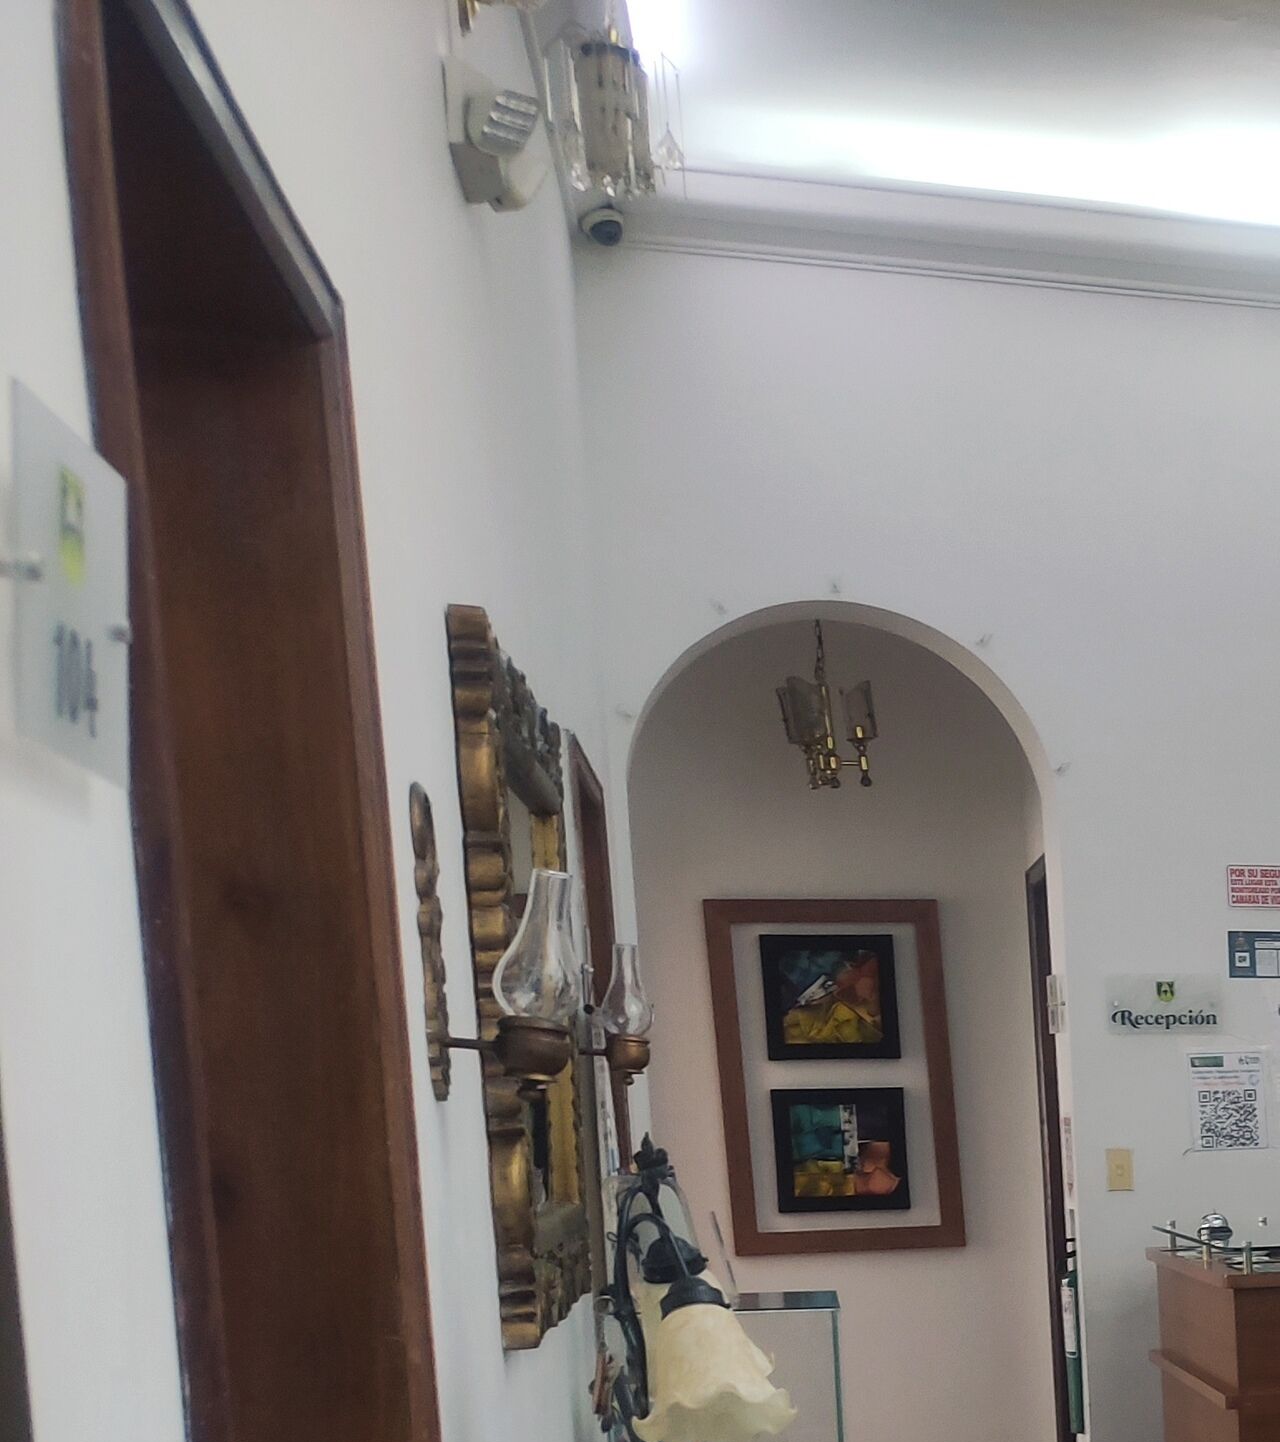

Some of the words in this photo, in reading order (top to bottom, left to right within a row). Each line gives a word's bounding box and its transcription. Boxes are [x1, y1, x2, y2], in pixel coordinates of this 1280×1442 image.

[1230, 868, 1245, 877] POR
[1248, 868, 1258, 877] SU
[1261, 895, 1269, 904] DE
[1111, 1009, 1217, 1029] Recepción
